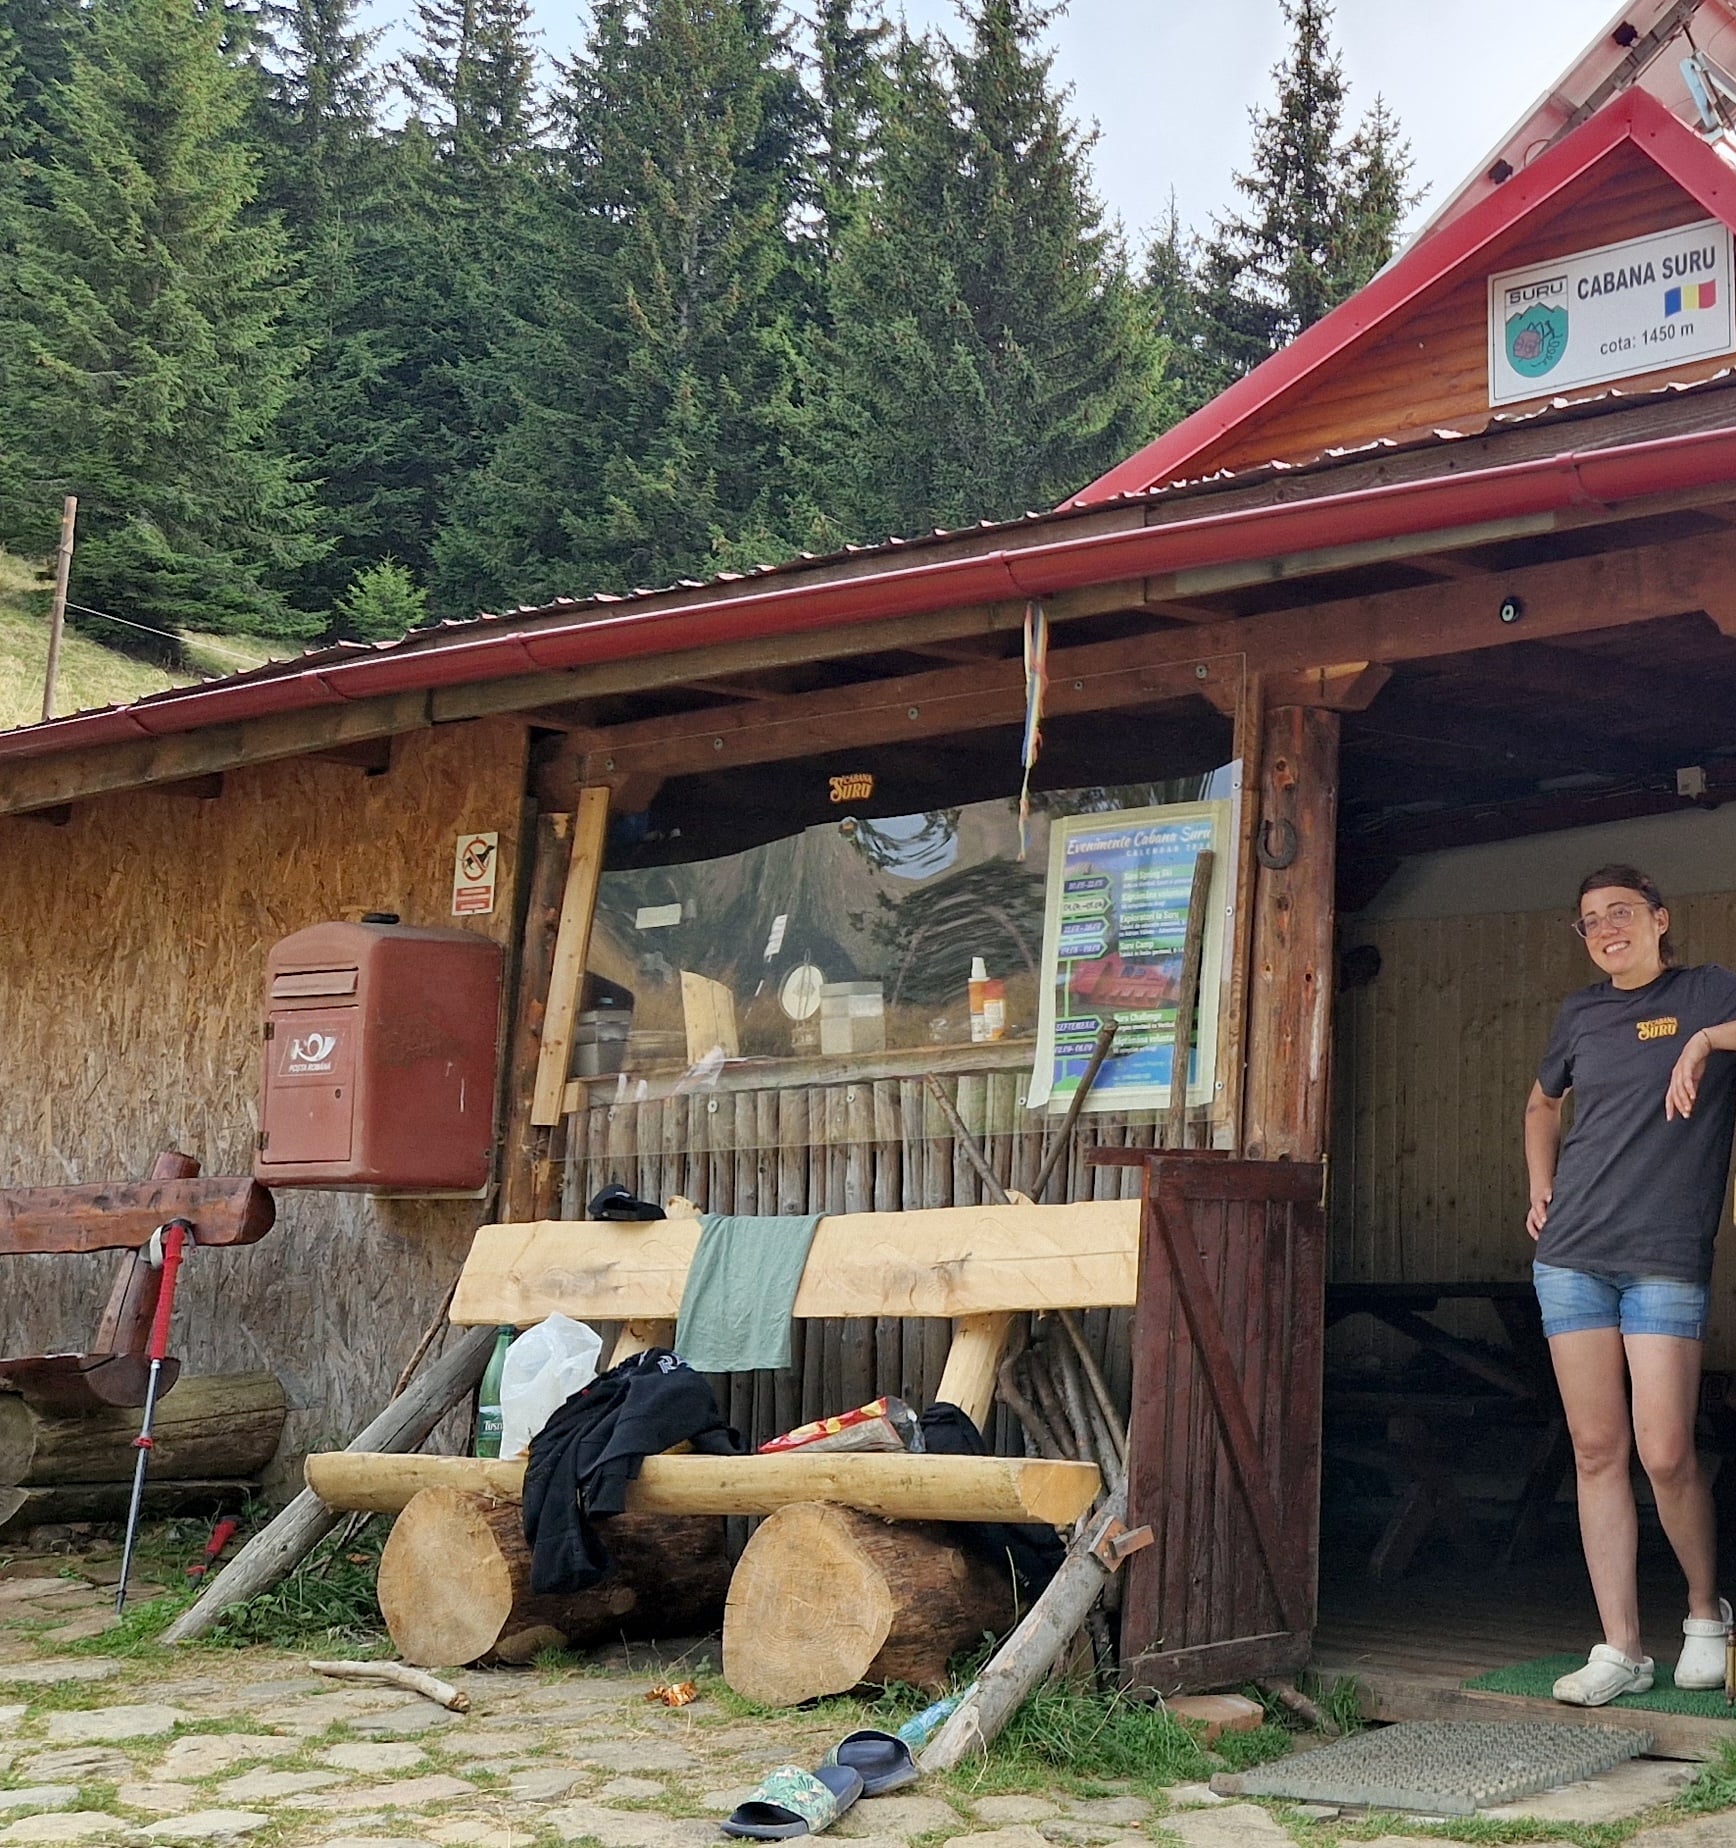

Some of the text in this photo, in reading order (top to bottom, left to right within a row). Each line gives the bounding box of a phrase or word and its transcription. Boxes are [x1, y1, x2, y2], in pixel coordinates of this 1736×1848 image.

[1578, 246, 1716, 300] CABANA SURU
[1509, 281, 1564, 304] SURU
[1600, 323, 1694, 355] cota: 1450 m
[829, 777, 872, 802] SURU
[1067, 826, 1211, 855] Evenimente Cabana Suru
[1636, 1021, 1677, 1040] SURU
